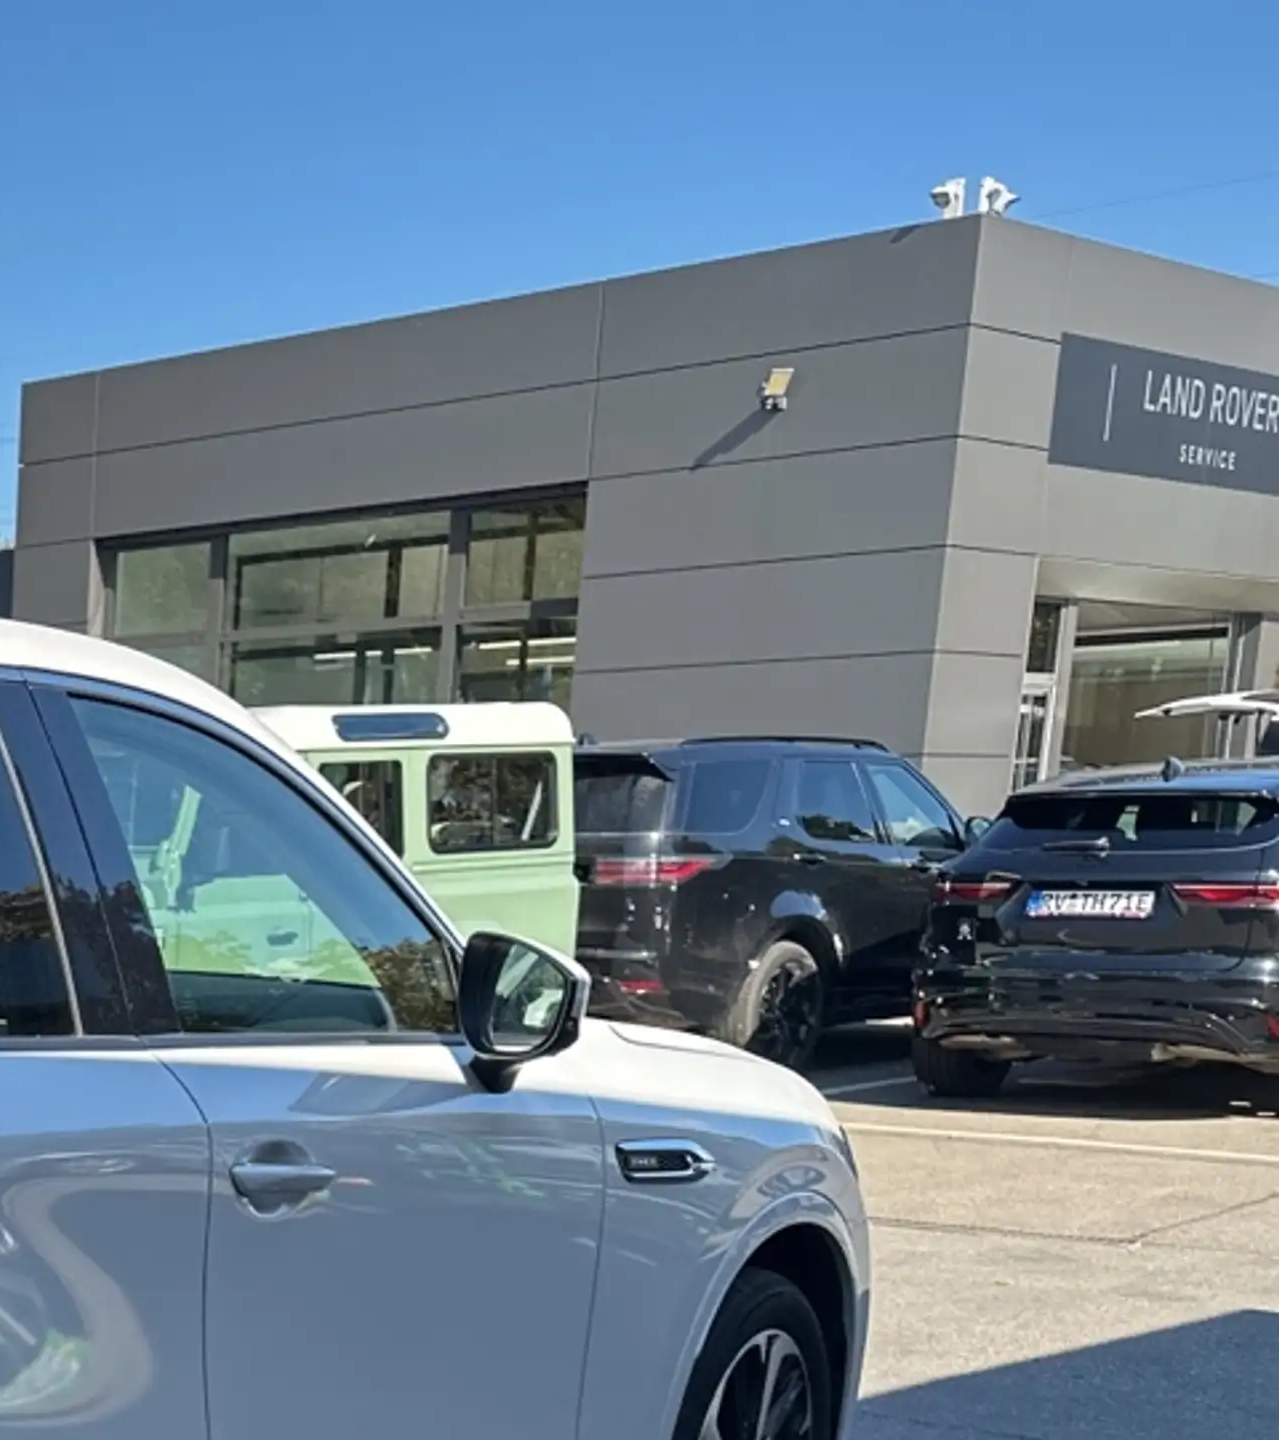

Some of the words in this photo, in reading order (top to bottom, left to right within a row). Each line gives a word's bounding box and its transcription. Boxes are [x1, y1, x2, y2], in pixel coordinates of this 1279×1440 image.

[1143, 369, 1205, 419] LAND
[1209, 383, 1279, 433] ROVER
[1178, 444, 1236, 471] SERVICE
